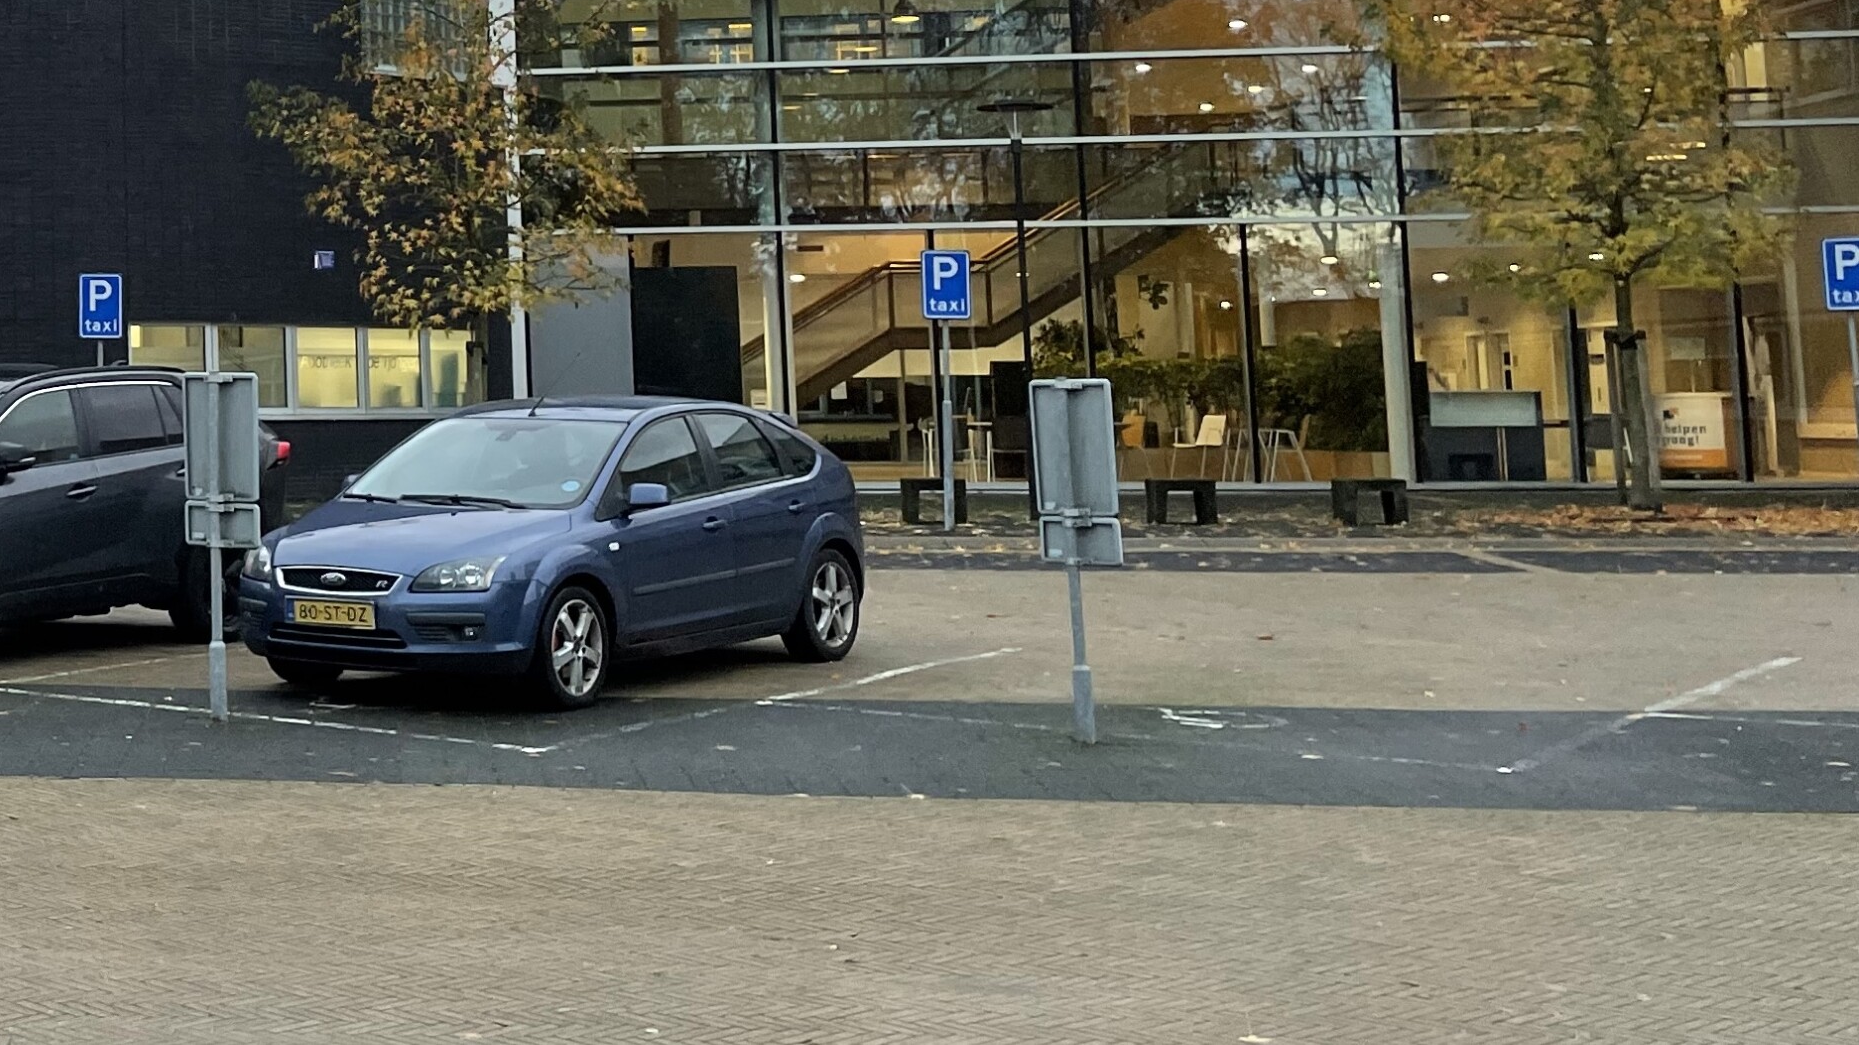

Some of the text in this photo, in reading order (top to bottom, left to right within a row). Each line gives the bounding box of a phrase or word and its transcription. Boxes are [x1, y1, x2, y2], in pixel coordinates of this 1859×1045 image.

[933, 255, 959, 291] P
[89, 279, 113, 312] P
[928, 297, 966, 313] taxi
[84, 318, 118, 333] taxi
[299, 603, 368, 623] 80-ST-DZ
